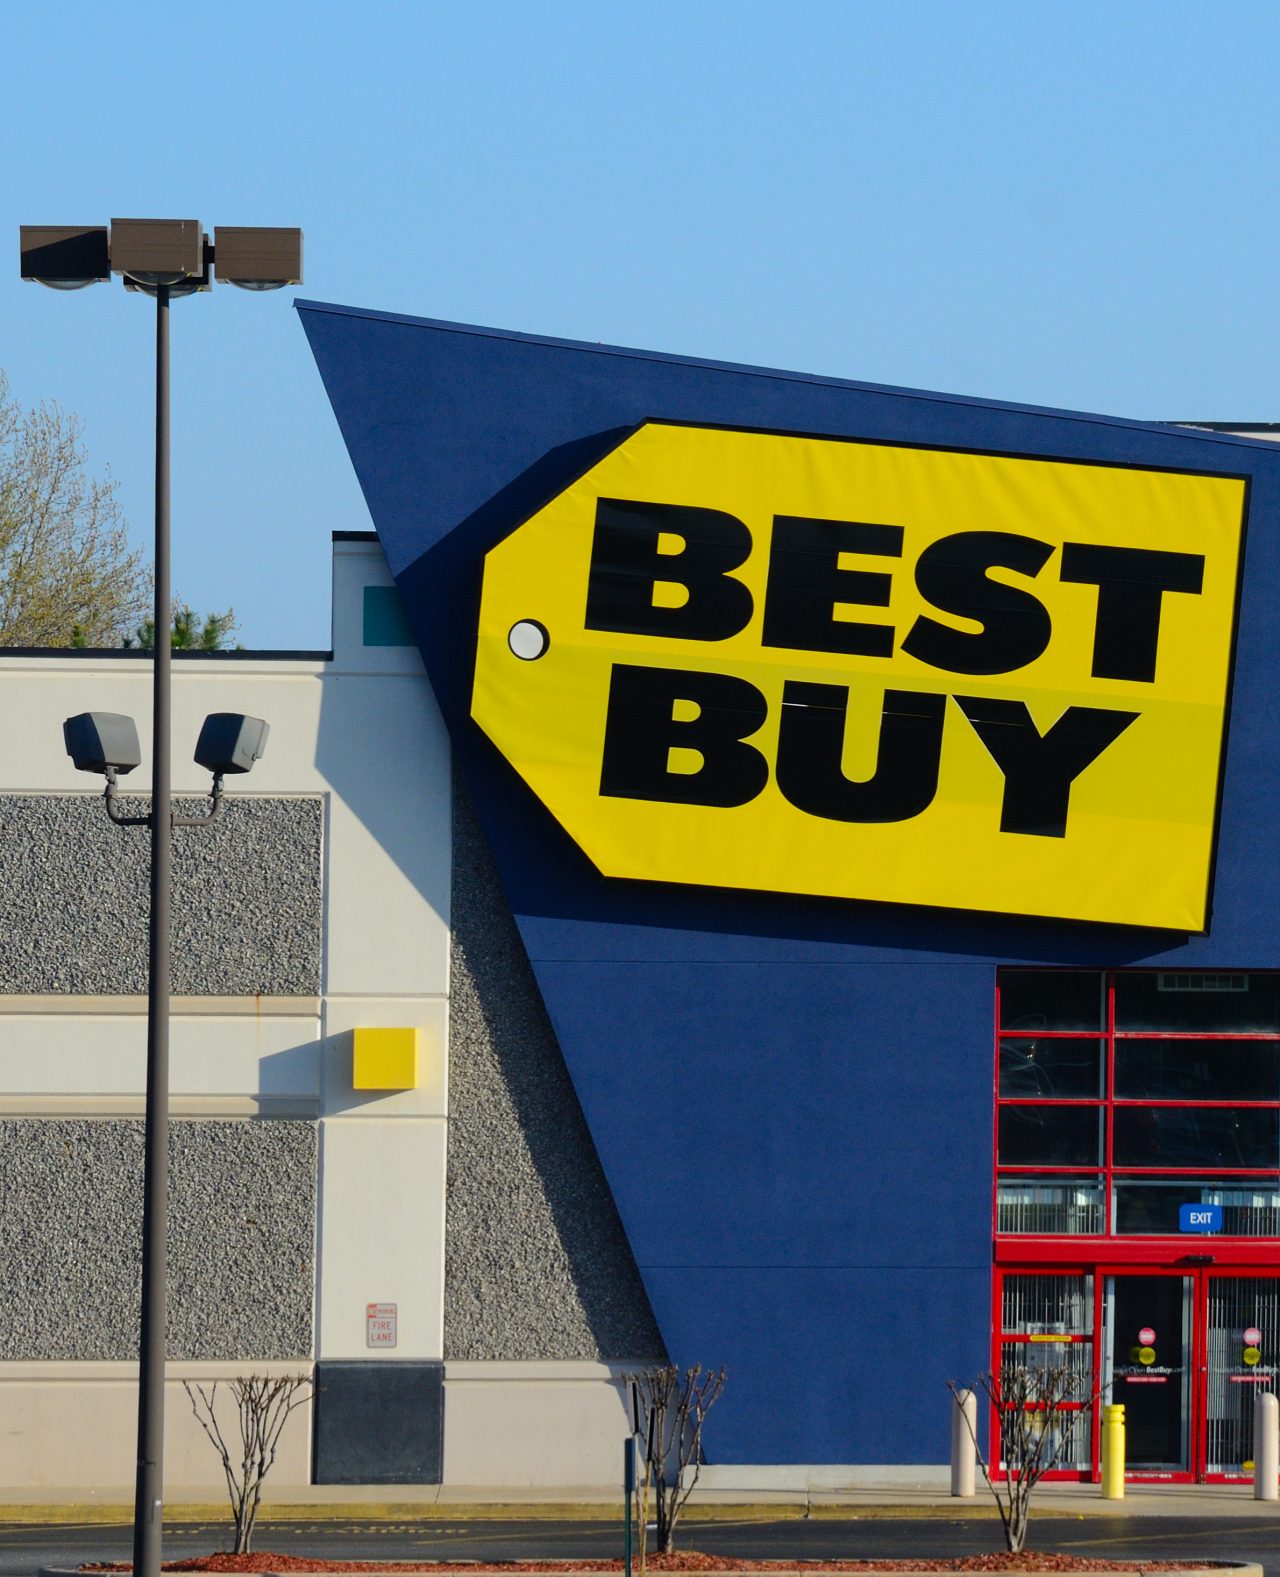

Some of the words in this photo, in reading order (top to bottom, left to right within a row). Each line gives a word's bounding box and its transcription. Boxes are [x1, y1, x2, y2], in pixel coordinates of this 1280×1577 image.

[584, 497, 1205, 683] BEST
[599, 663, 1142, 838] BUY
[1190, 1212, 1213, 1225] EXIT
[372, 1320, 391, 1330] FIRE
[371, 1332, 393, 1342] LANE
